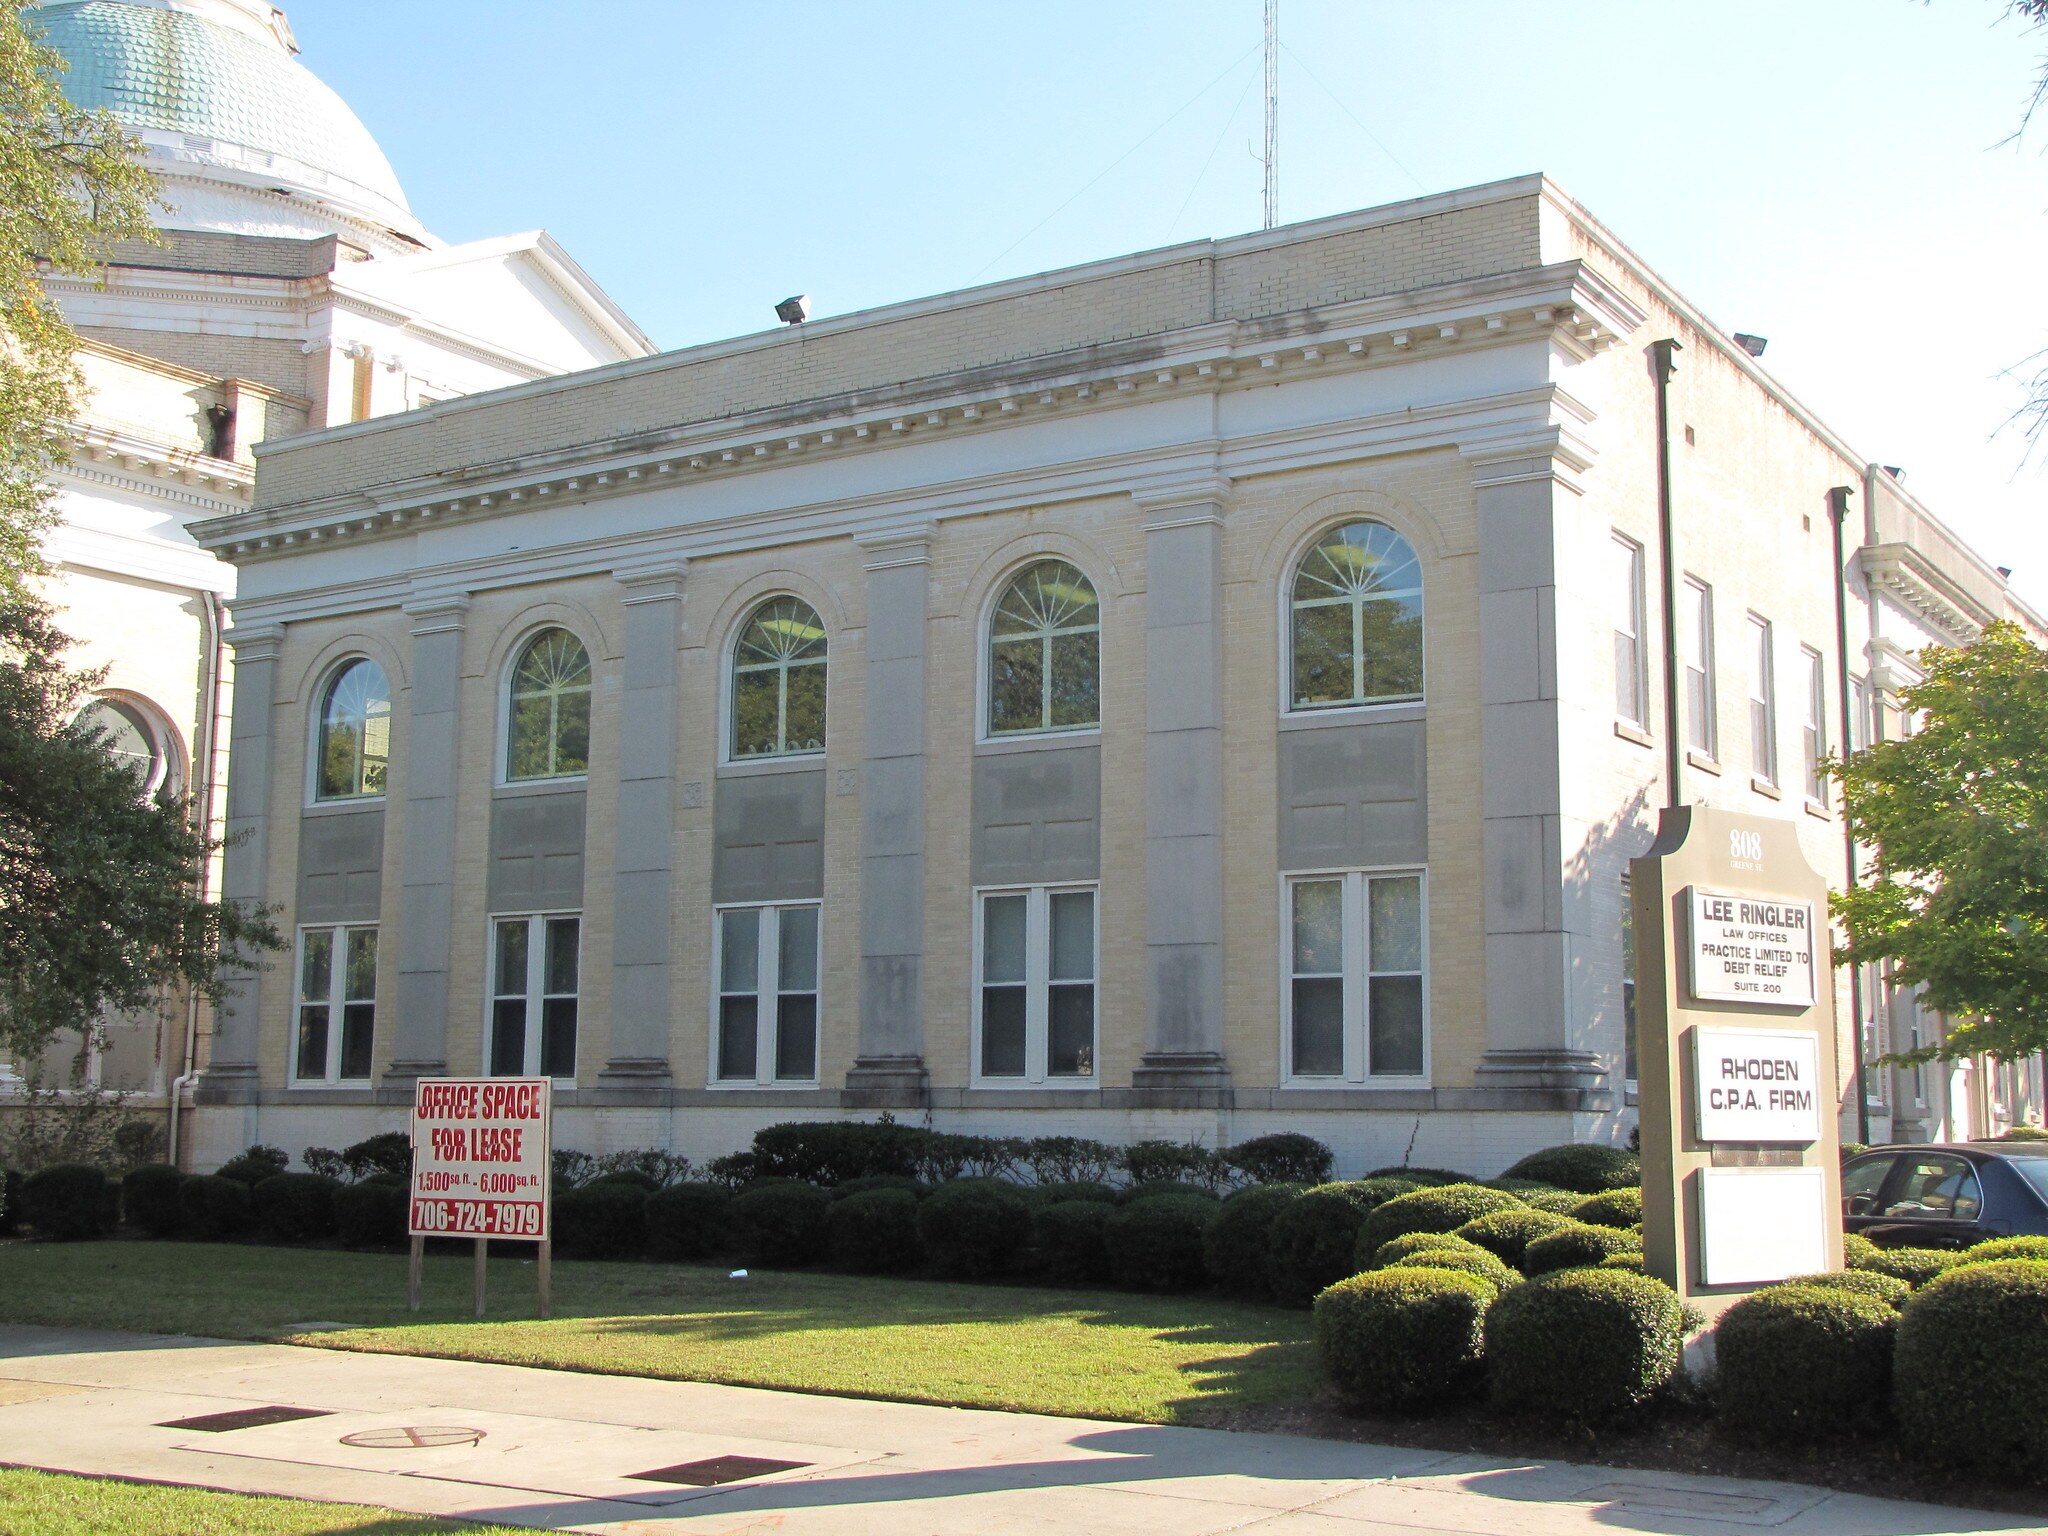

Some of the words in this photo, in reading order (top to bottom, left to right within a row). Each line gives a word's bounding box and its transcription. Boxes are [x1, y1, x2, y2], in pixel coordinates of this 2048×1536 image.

[1730, 829, 1761, 860] 808
[1703, 899, 1733, 922] LEE
[1740, 903, 1805, 929] RINGLER
[1723, 928, 1744, 938] LAW
[1748, 931, 1787, 943] OFFICES
[1702, 943, 1751, 959] PRACTICE
[1755, 949, 1792, 962] LIMITED
[1796, 952, 1808, 964] TO
[1724, 962, 1750, 974] DEBT
[1755, 964, 1787, 977] RELIEF
[1734, 982, 1759, 991] SUITE
[1763, 984, 1781, 993] 200
[1721, 1058, 1798, 1081] RHODEN
[418, 1085, 479, 1119] OFFICE
[482, 1085, 540, 1120] SPACE
[1710, 1089, 1761, 1110] C.P.A.
[1770, 1090, 1811, 1110] FIRM
[432, 1128, 467, 1161] FOR
[471, 1128, 522, 1162] LEASE
[415, 1200, 539, 1234] 706-724-7979
